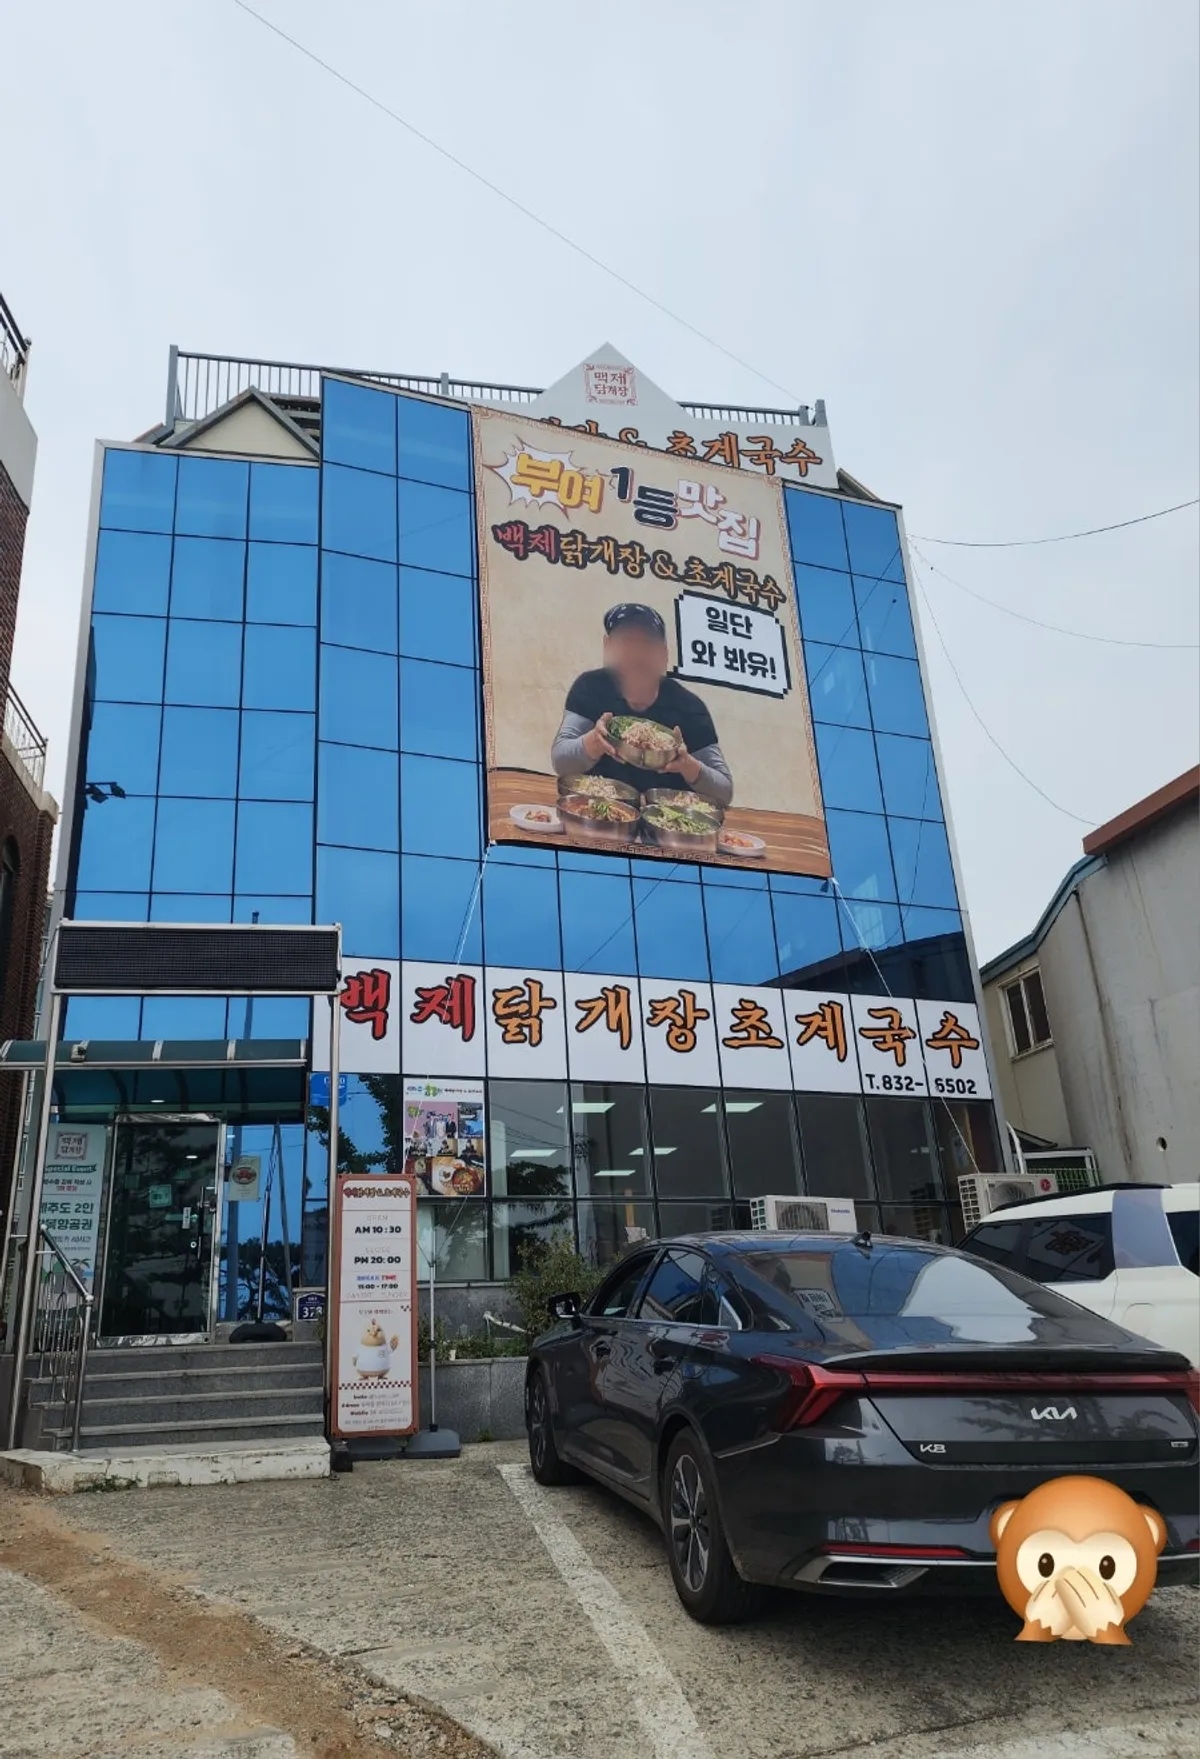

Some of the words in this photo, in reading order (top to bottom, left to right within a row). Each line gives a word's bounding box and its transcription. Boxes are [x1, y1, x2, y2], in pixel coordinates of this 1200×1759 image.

[510, 453, 607, 514] 부여
[491, 520, 650, 579] 백제닭개장
[650, 550, 682, 580] &
[682, 555, 786, 610] 초계국수
[705, 606, 754, 641] 일단
[691, 640, 717, 669] 와
[723, 647, 778, 681] 봐유!
[355, 1226, 370, 1234] AM
[354, 1256, 368, 1264] PM
[919, 1443, 946, 1453] K8
